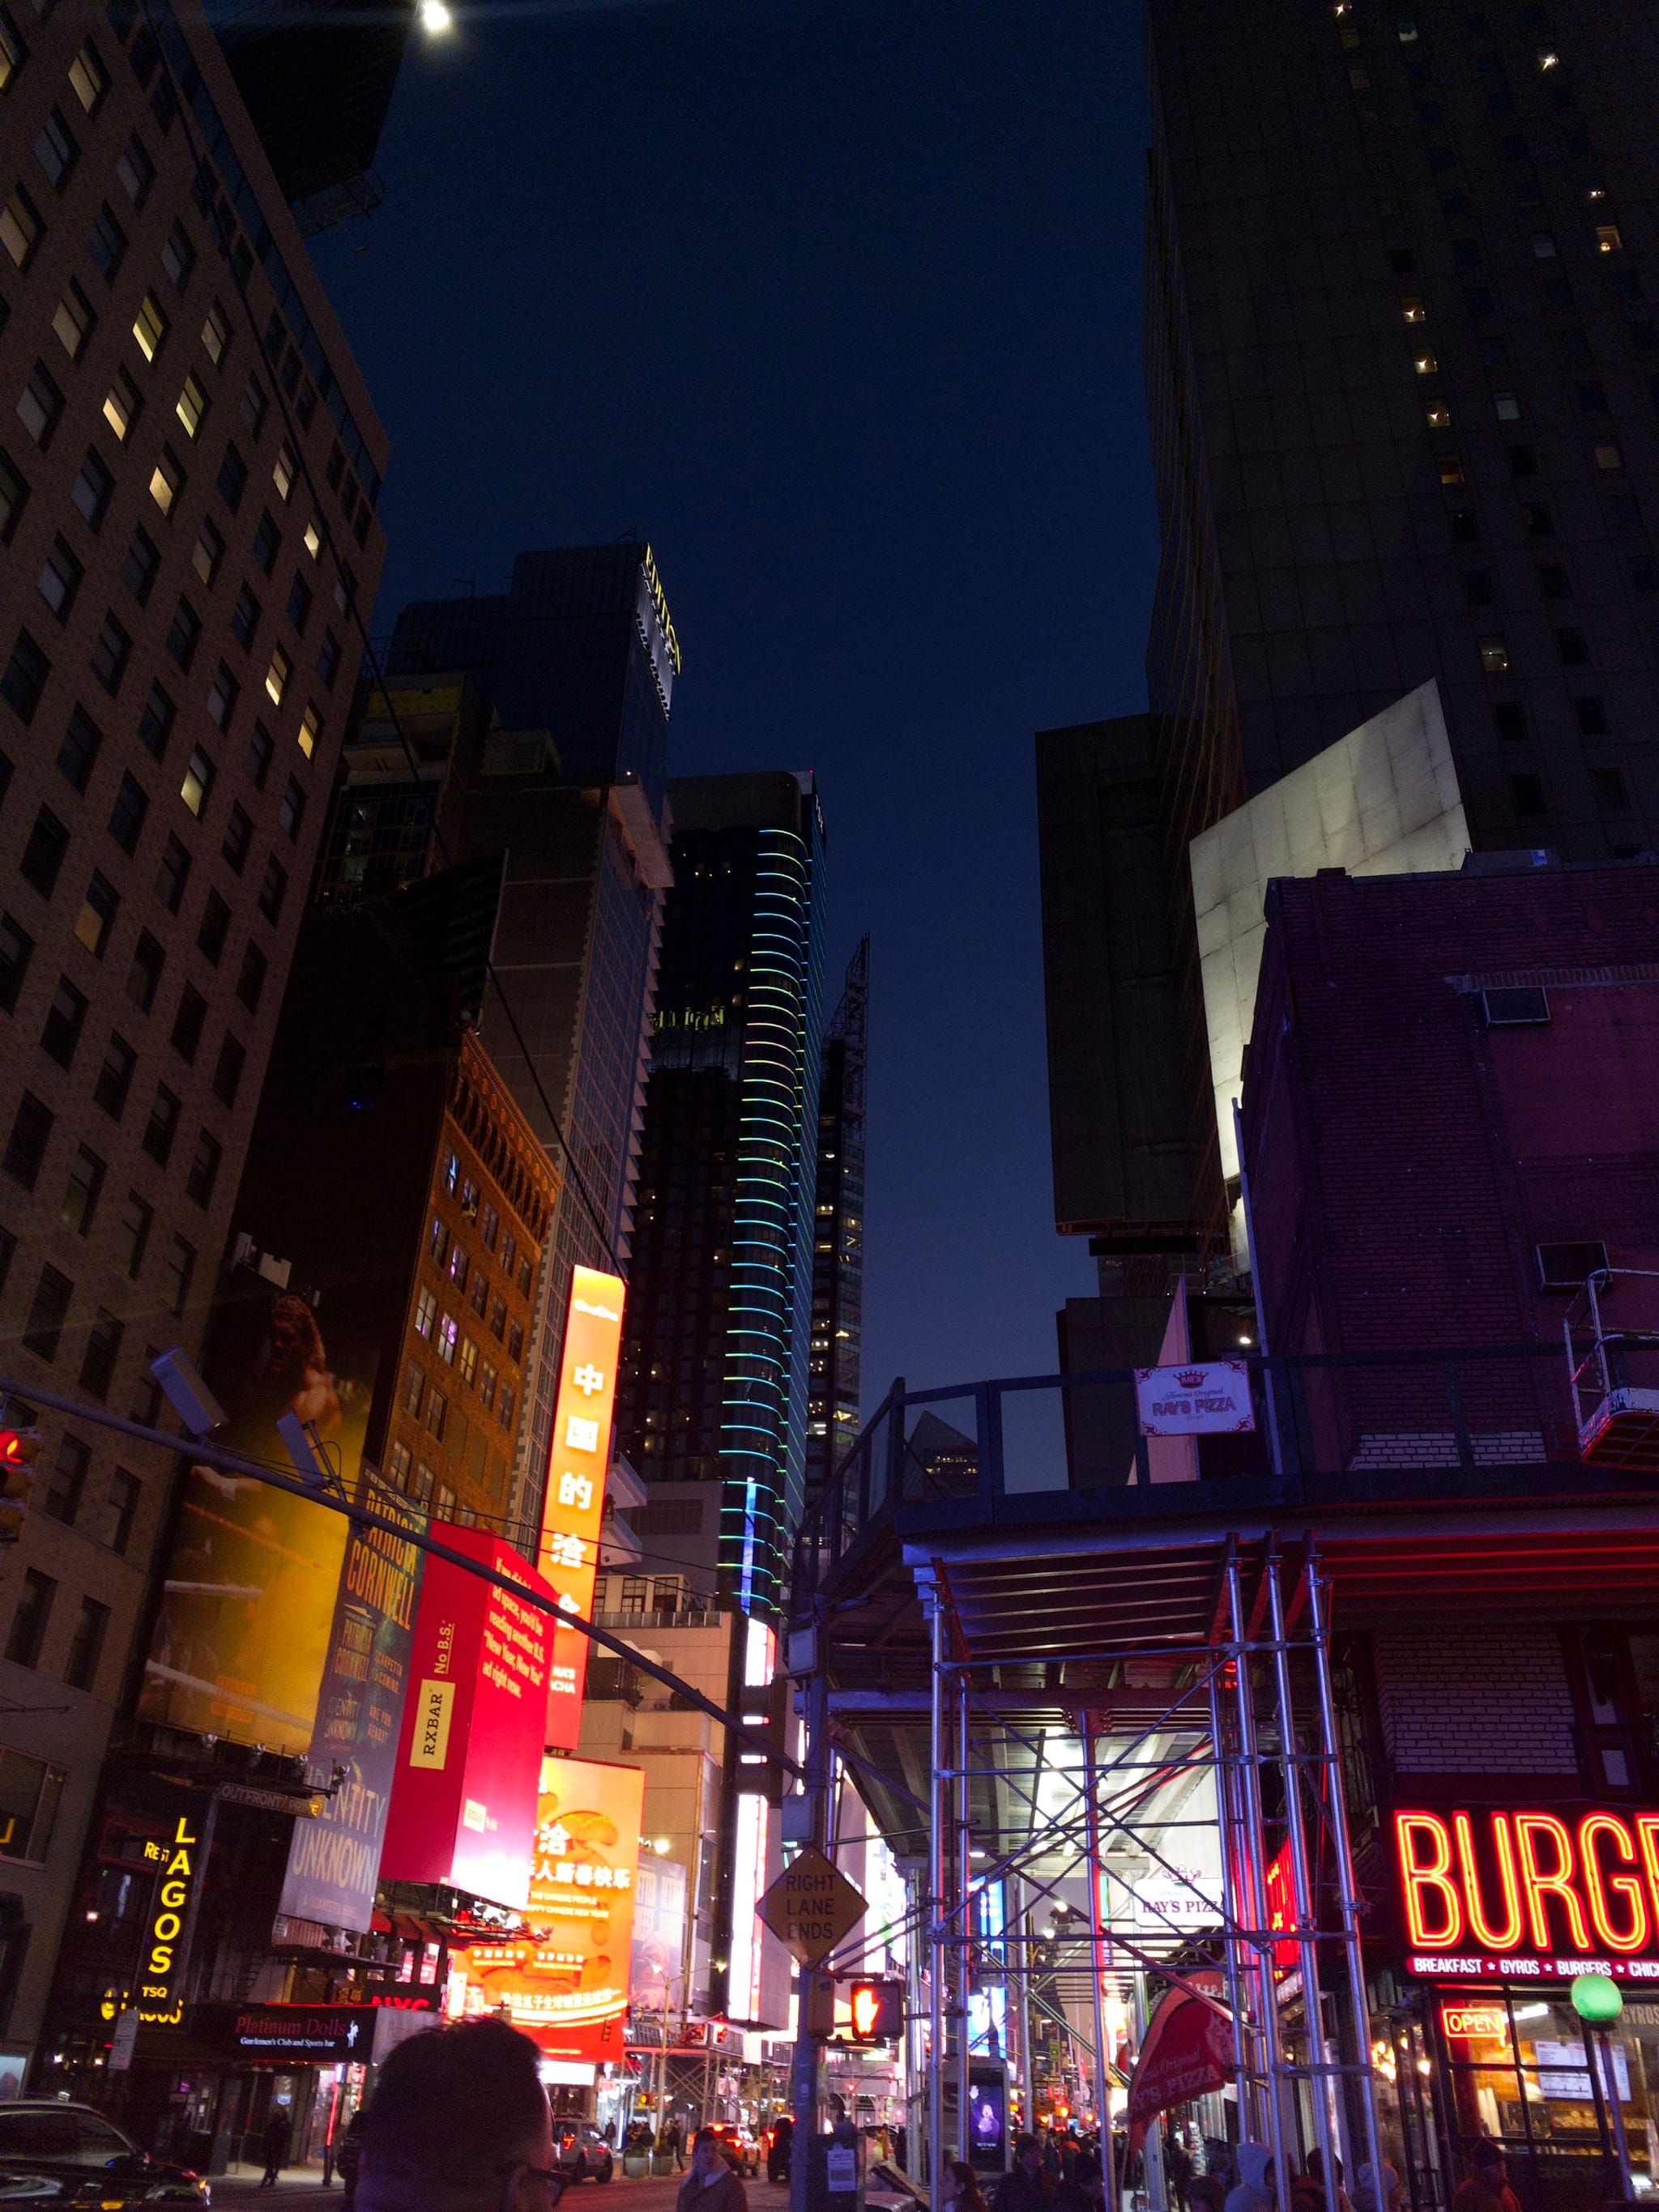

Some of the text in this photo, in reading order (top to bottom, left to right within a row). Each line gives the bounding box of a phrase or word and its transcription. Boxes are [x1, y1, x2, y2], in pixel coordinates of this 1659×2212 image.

[1194, 1387, 1224, 1398] Original
[1153, 1396, 1237, 1416] RAY'S PIZZA
[347, 1538, 415, 1631] CORNWELL
[501, 1592, 520, 1619] space,
[535, 1617, 543, 1637] be
[489, 1610, 512, 1641] reading
[512, 1625, 534, 1655] another
[434, 1622, 454, 1675] No B.S.
[482, 1660, 493, 1678] ad
[492, 1665, 508, 1688] right
[516, 1654, 530, 1678] New
[423, 1693, 443, 1756] RXBAR
[292, 1822, 377, 1896] UNKNOWN
[787, 1874, 835, 1892] RIGHT
[147, 1817, 196, 1974] LAGOS
[544, 1892, 572, 1903] CHINESE
[572, 1894, 598, 1905] PEOPLE
[546, 1905, 574, 1916] CHINESE
[787, 1898, 835, 1916] LANE
[1142, 1899, 1224, 1913] RAY'S PIZZ
[787, 1922, 833, 1940] ENDS
[1414, 1958, 1482, 1974] BREAKFAST
[1499, 1959, 1540, 1975] GYROS
[1556, 1960, 1612, 1977] BURGERS
[142, 1986, 168, 1998] TSQ
[236, 2016, 346, 2037] Platinum Dolls
[1448, 2014, 1499, 2032] OPEN
[276, 2037, 292, 2047] Club
[292, 2038, 304, 2047] and
[304, 2038, 324, 2048] Sports
[324, 2039, 336, 2048] bar
